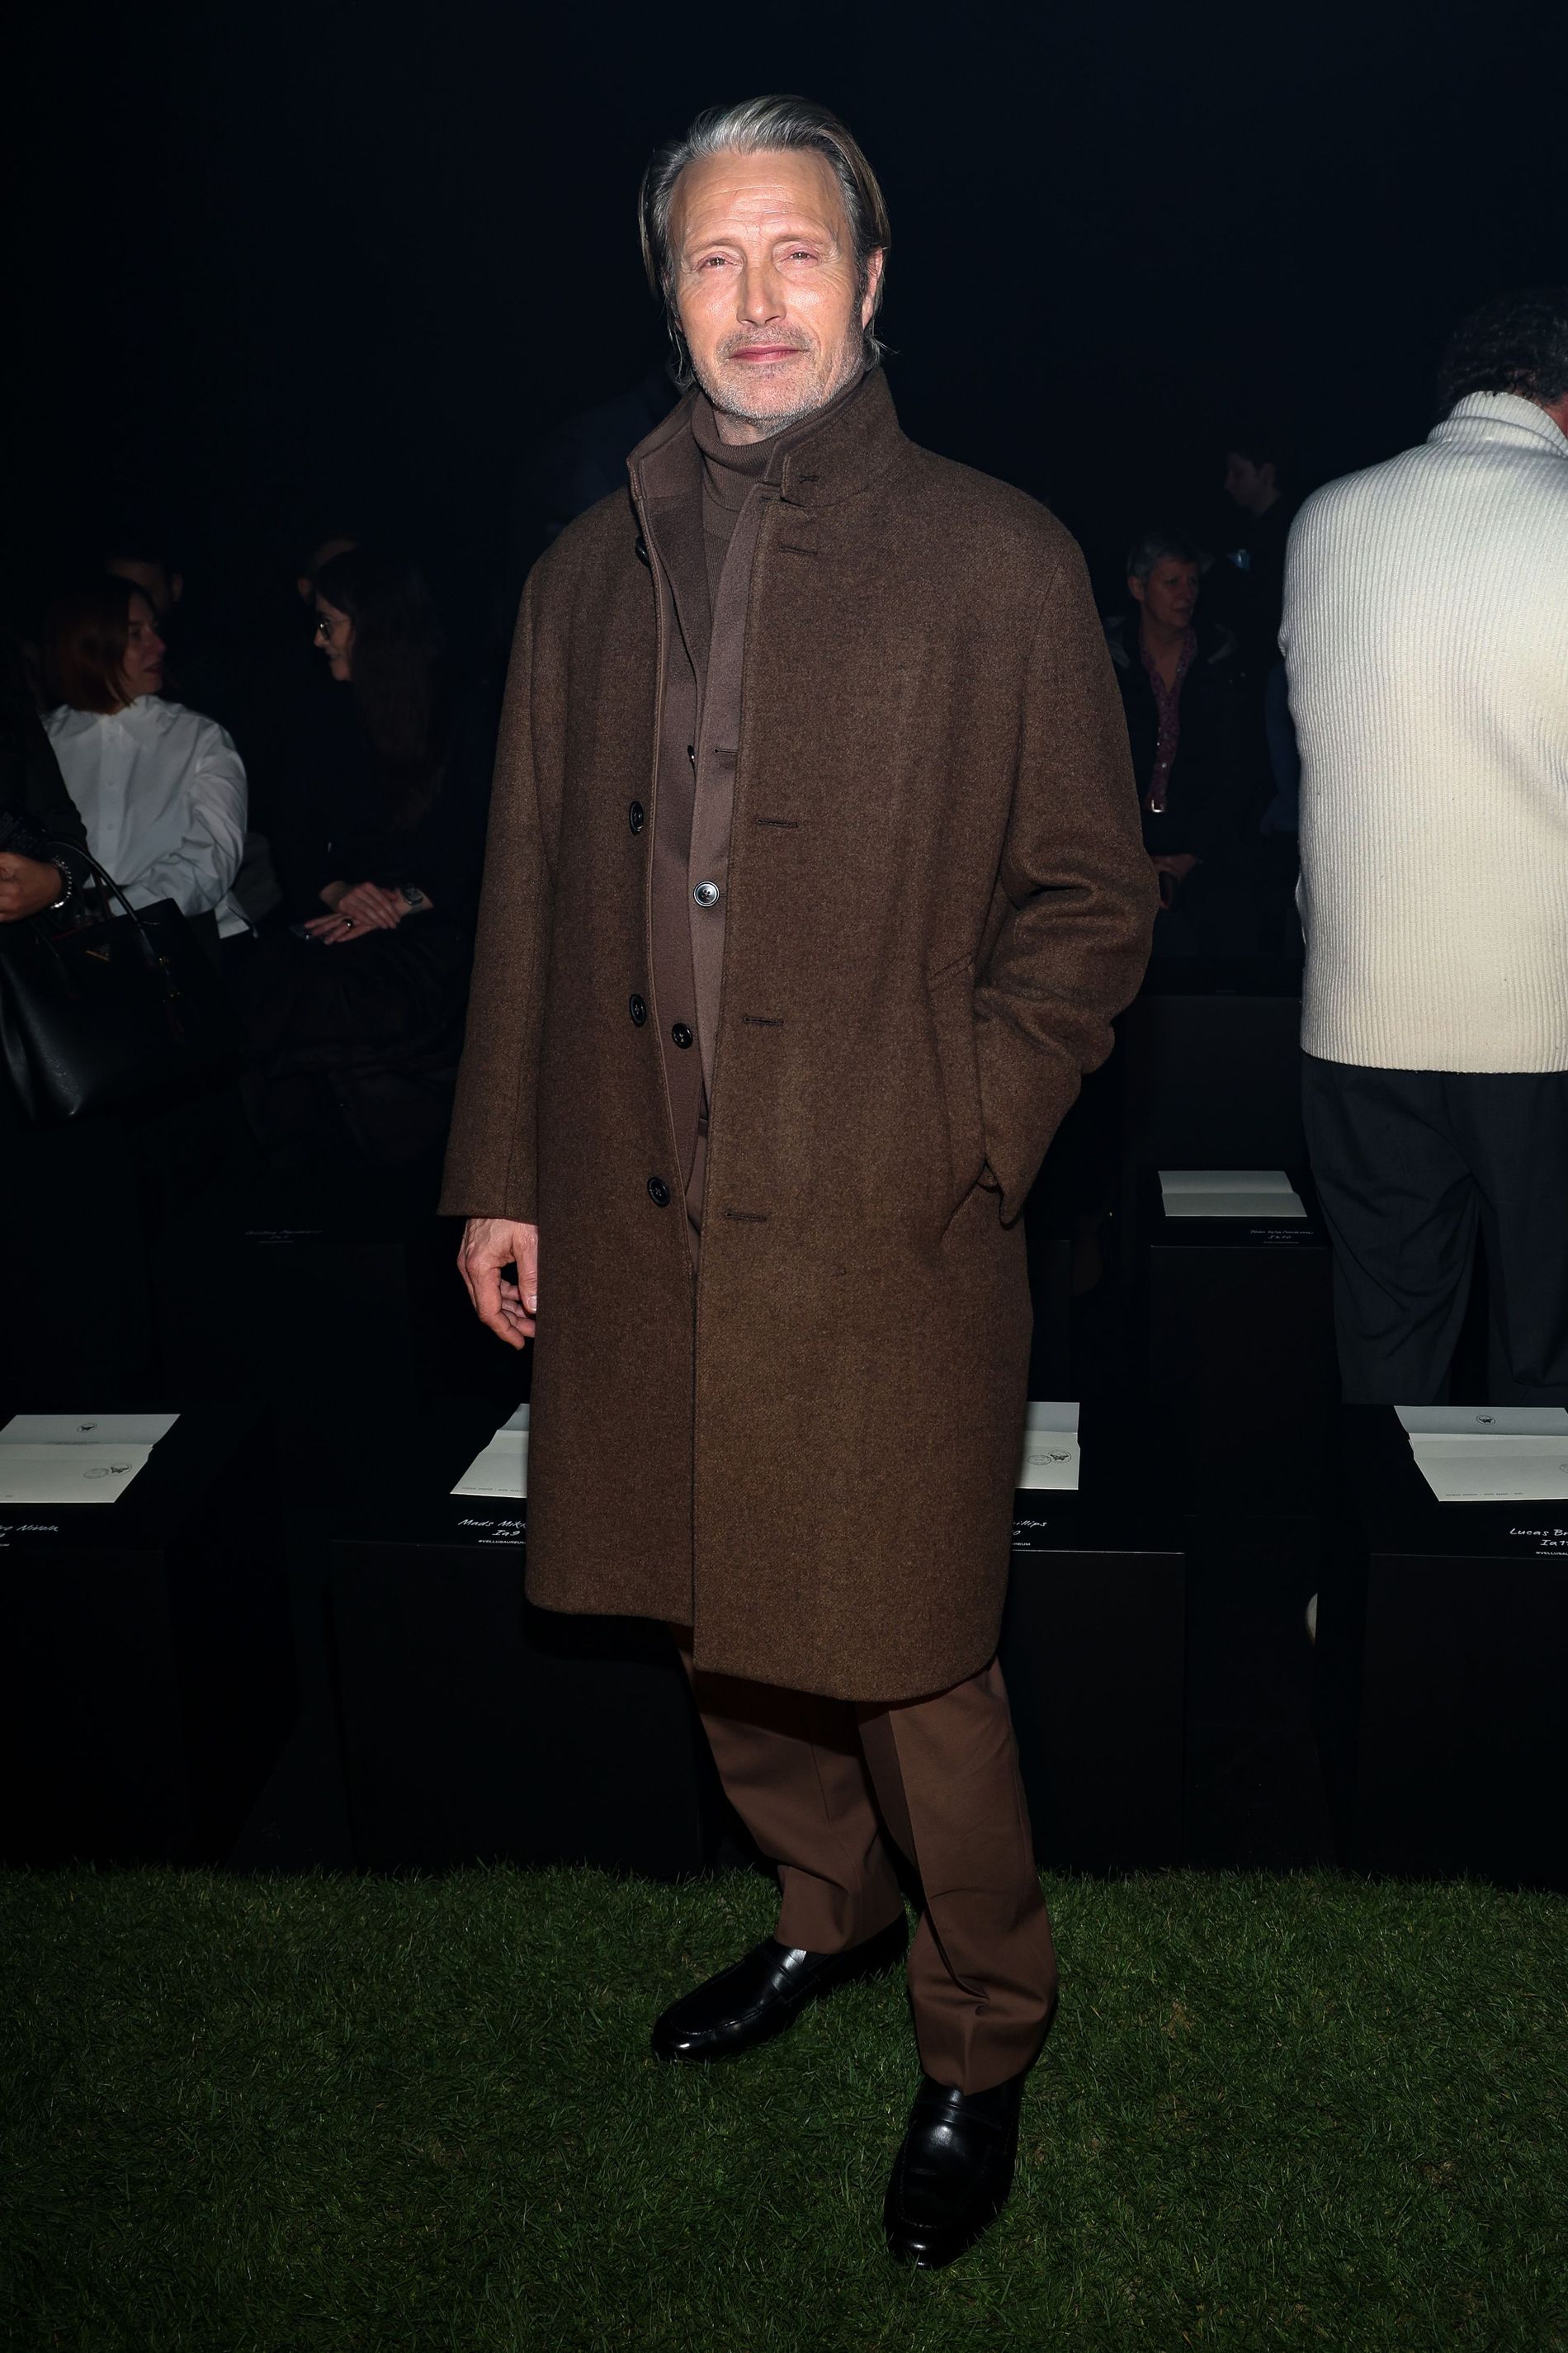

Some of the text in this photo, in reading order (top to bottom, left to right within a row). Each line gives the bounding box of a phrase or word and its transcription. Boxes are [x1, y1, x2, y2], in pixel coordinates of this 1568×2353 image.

[457, 1519, 494, 1527] Mads
[1012, 1519, 1048, 1528] illips
[1509, 1528, 1549, 1537] Lucas
